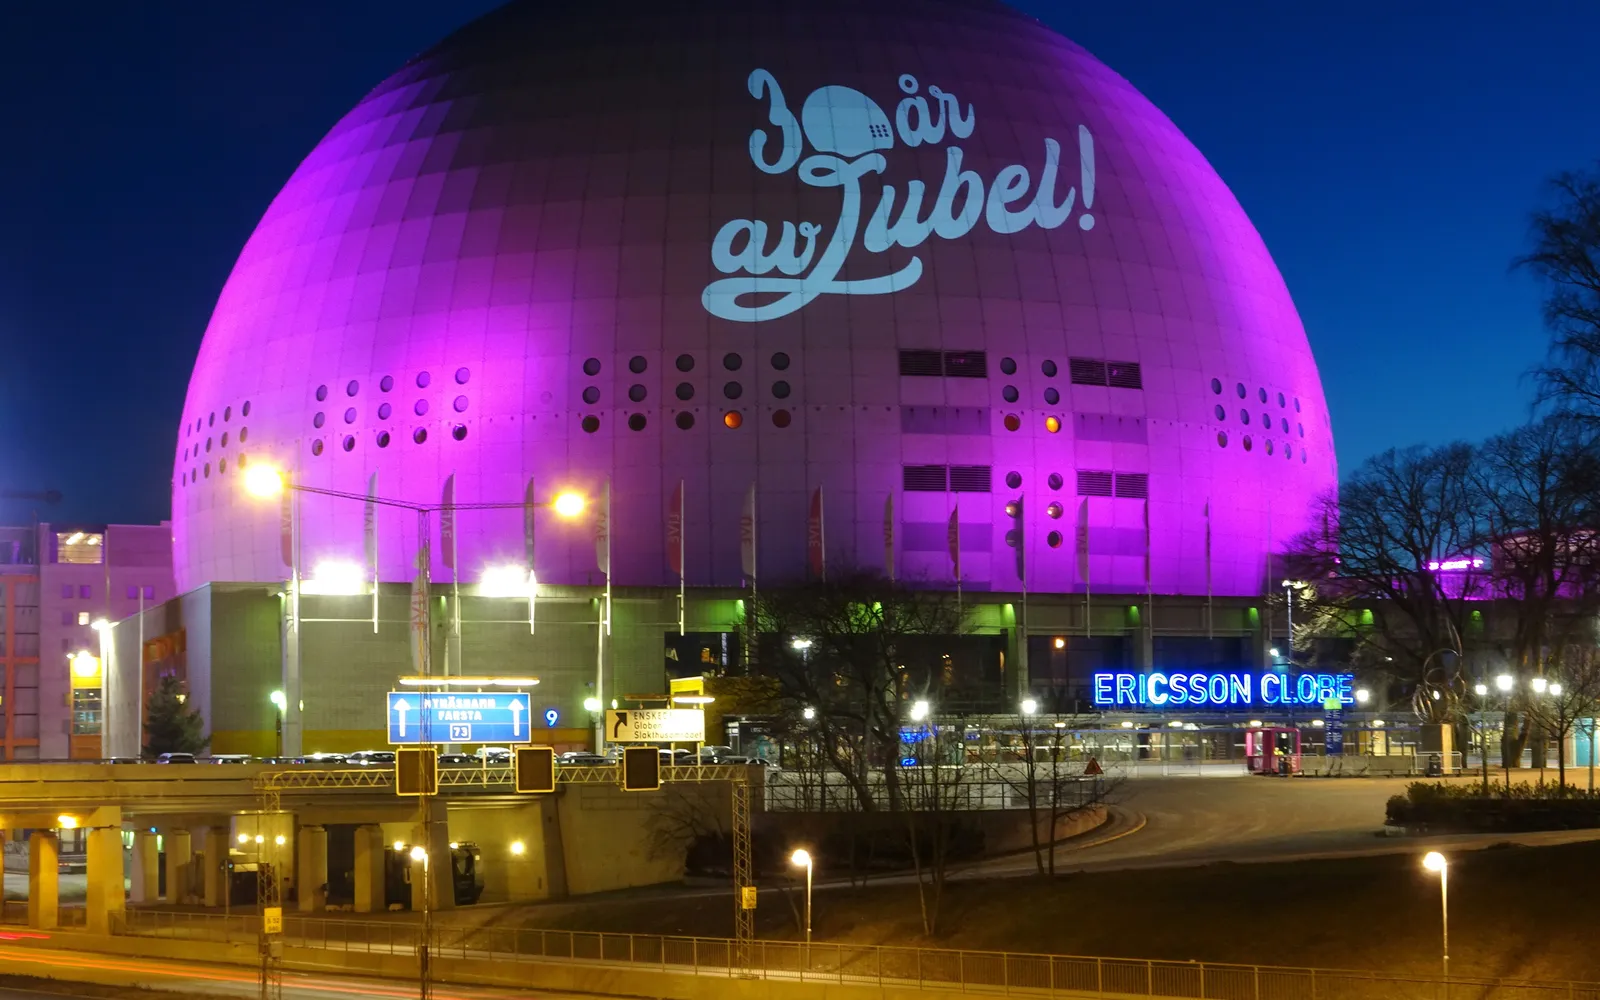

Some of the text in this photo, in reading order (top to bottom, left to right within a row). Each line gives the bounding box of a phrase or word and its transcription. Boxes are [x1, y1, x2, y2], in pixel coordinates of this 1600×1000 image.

[896, 74, 976, 147] år
[711, 219, 821, 275] av
[1094, 673, 1251, 705] ERICSSON
[438, 710, 483, 721] FARSTA
[546, 709, 558, 727] 9
[453, 726, 469, 737] 73
